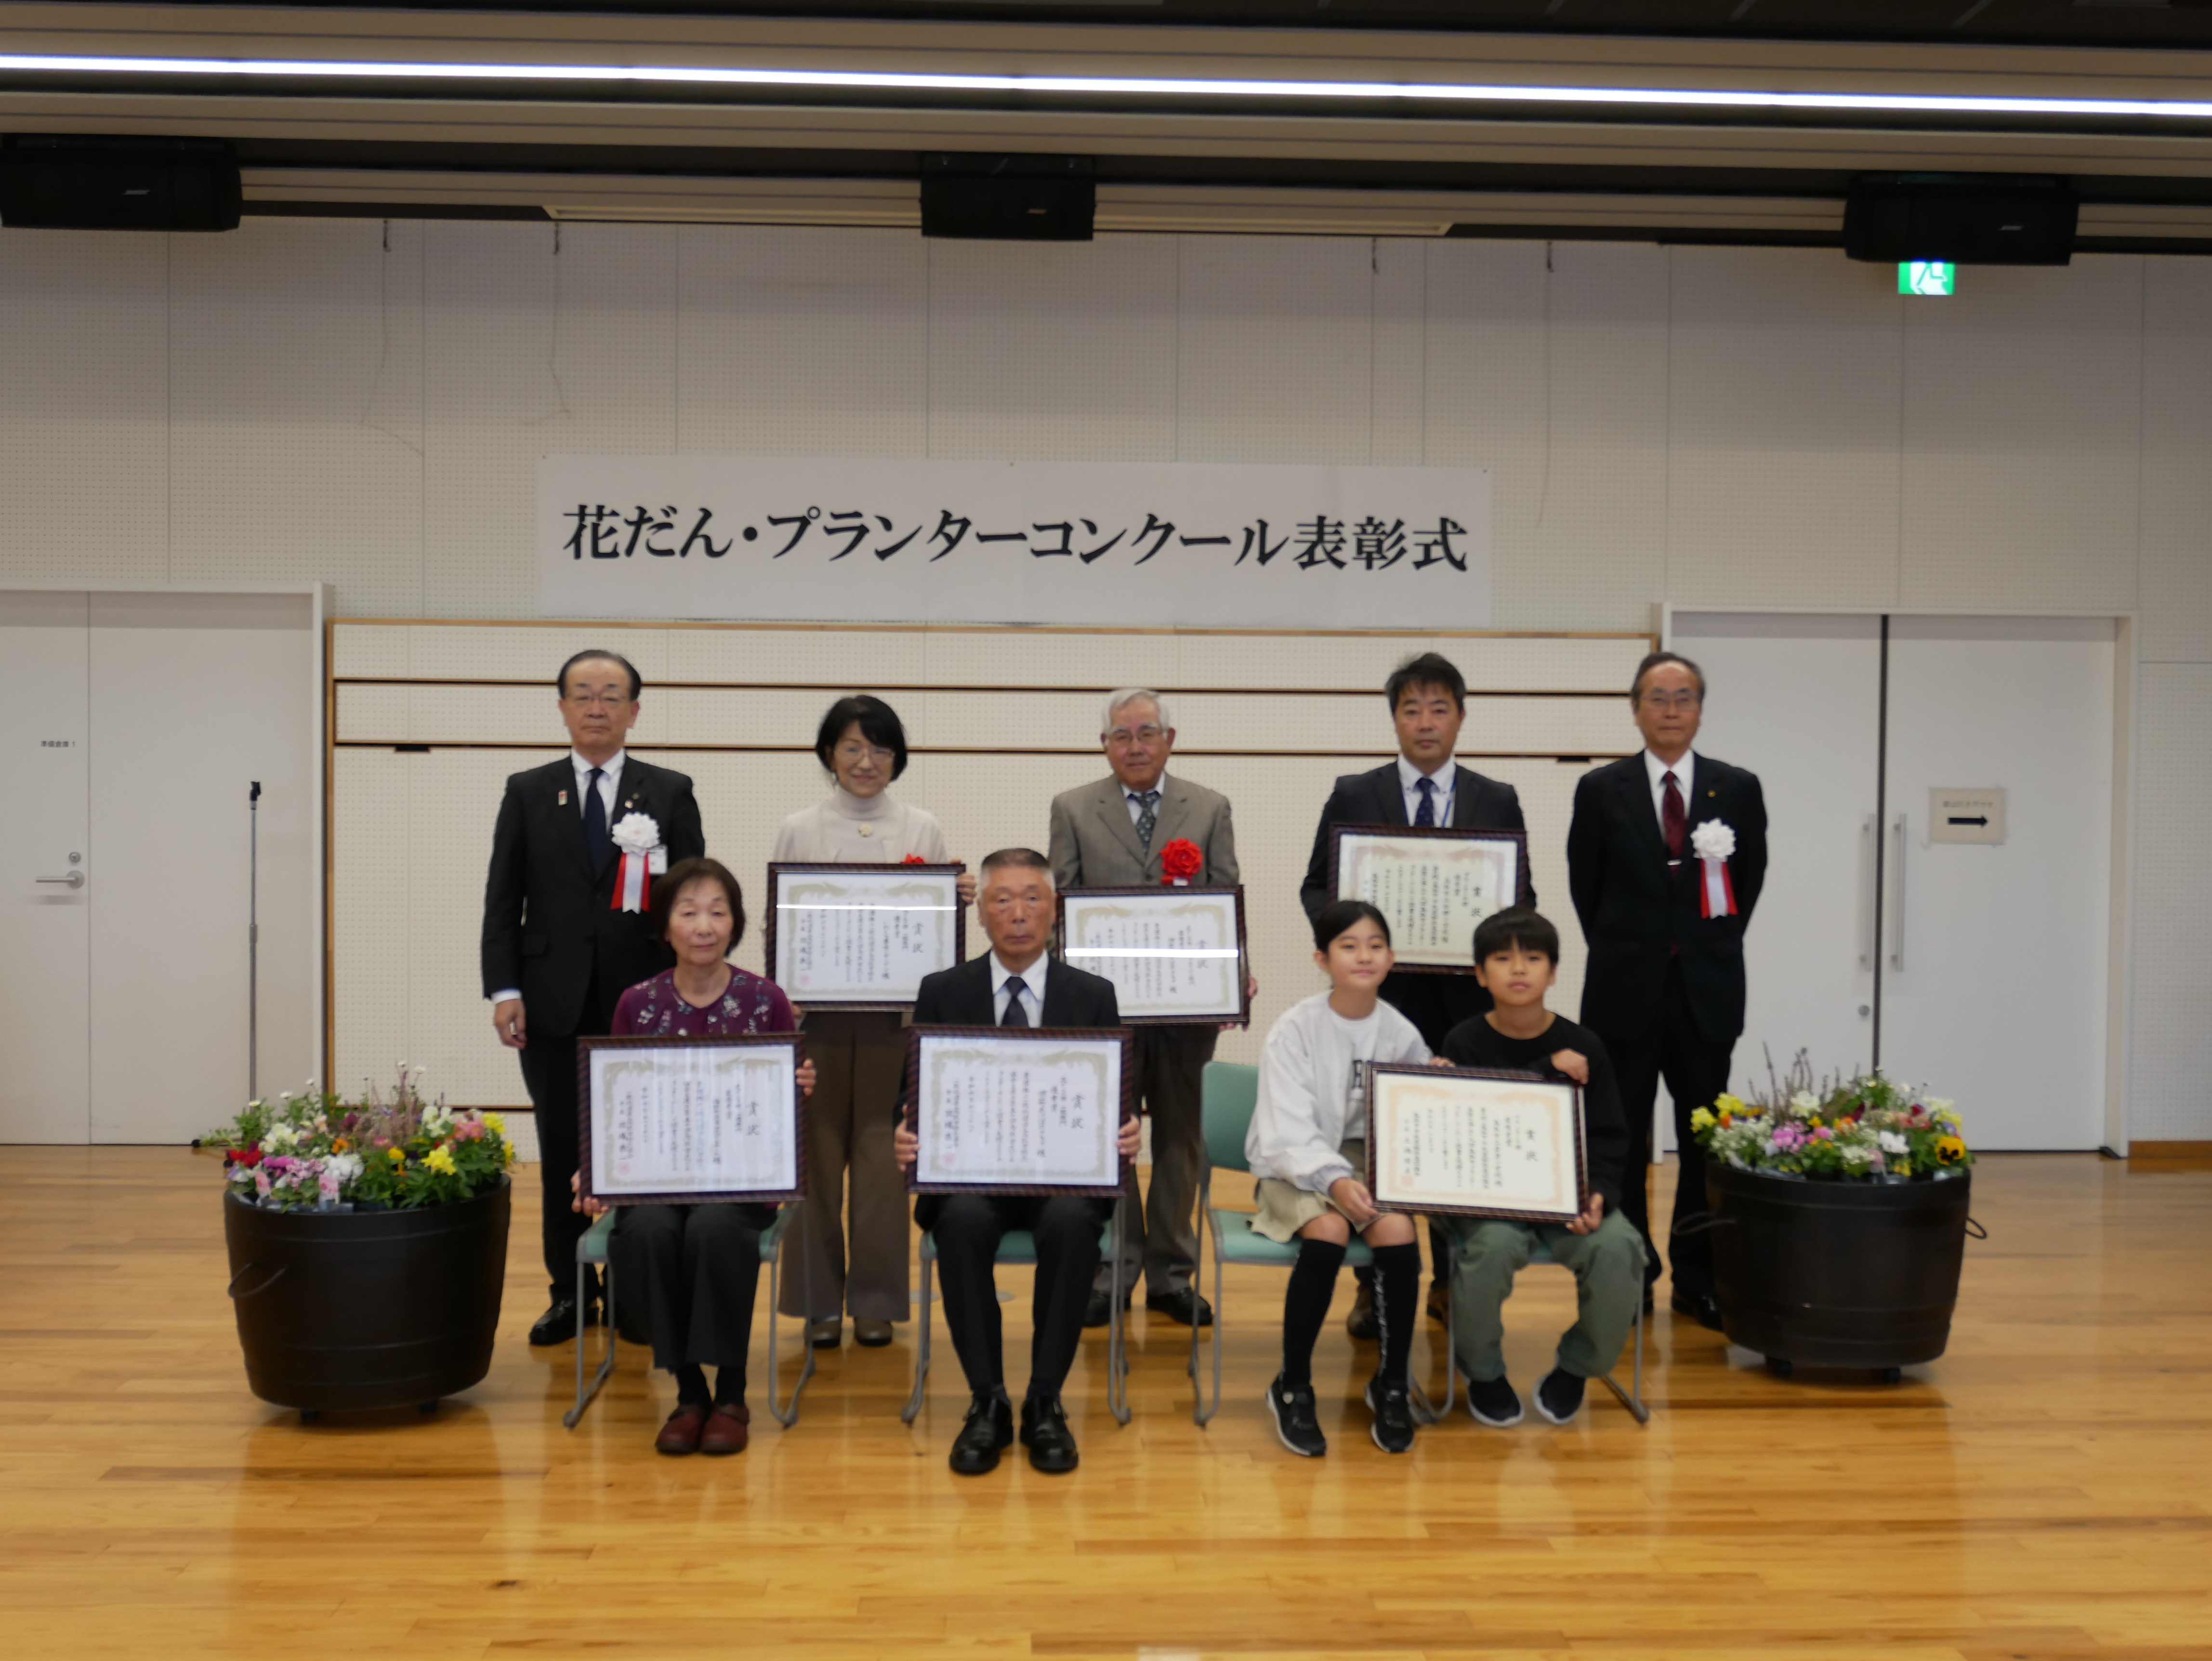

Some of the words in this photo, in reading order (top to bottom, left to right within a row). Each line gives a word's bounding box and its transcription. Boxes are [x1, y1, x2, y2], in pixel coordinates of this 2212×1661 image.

[562, 503, 1469, 573] 花だん・プランターコンクール表彰式
